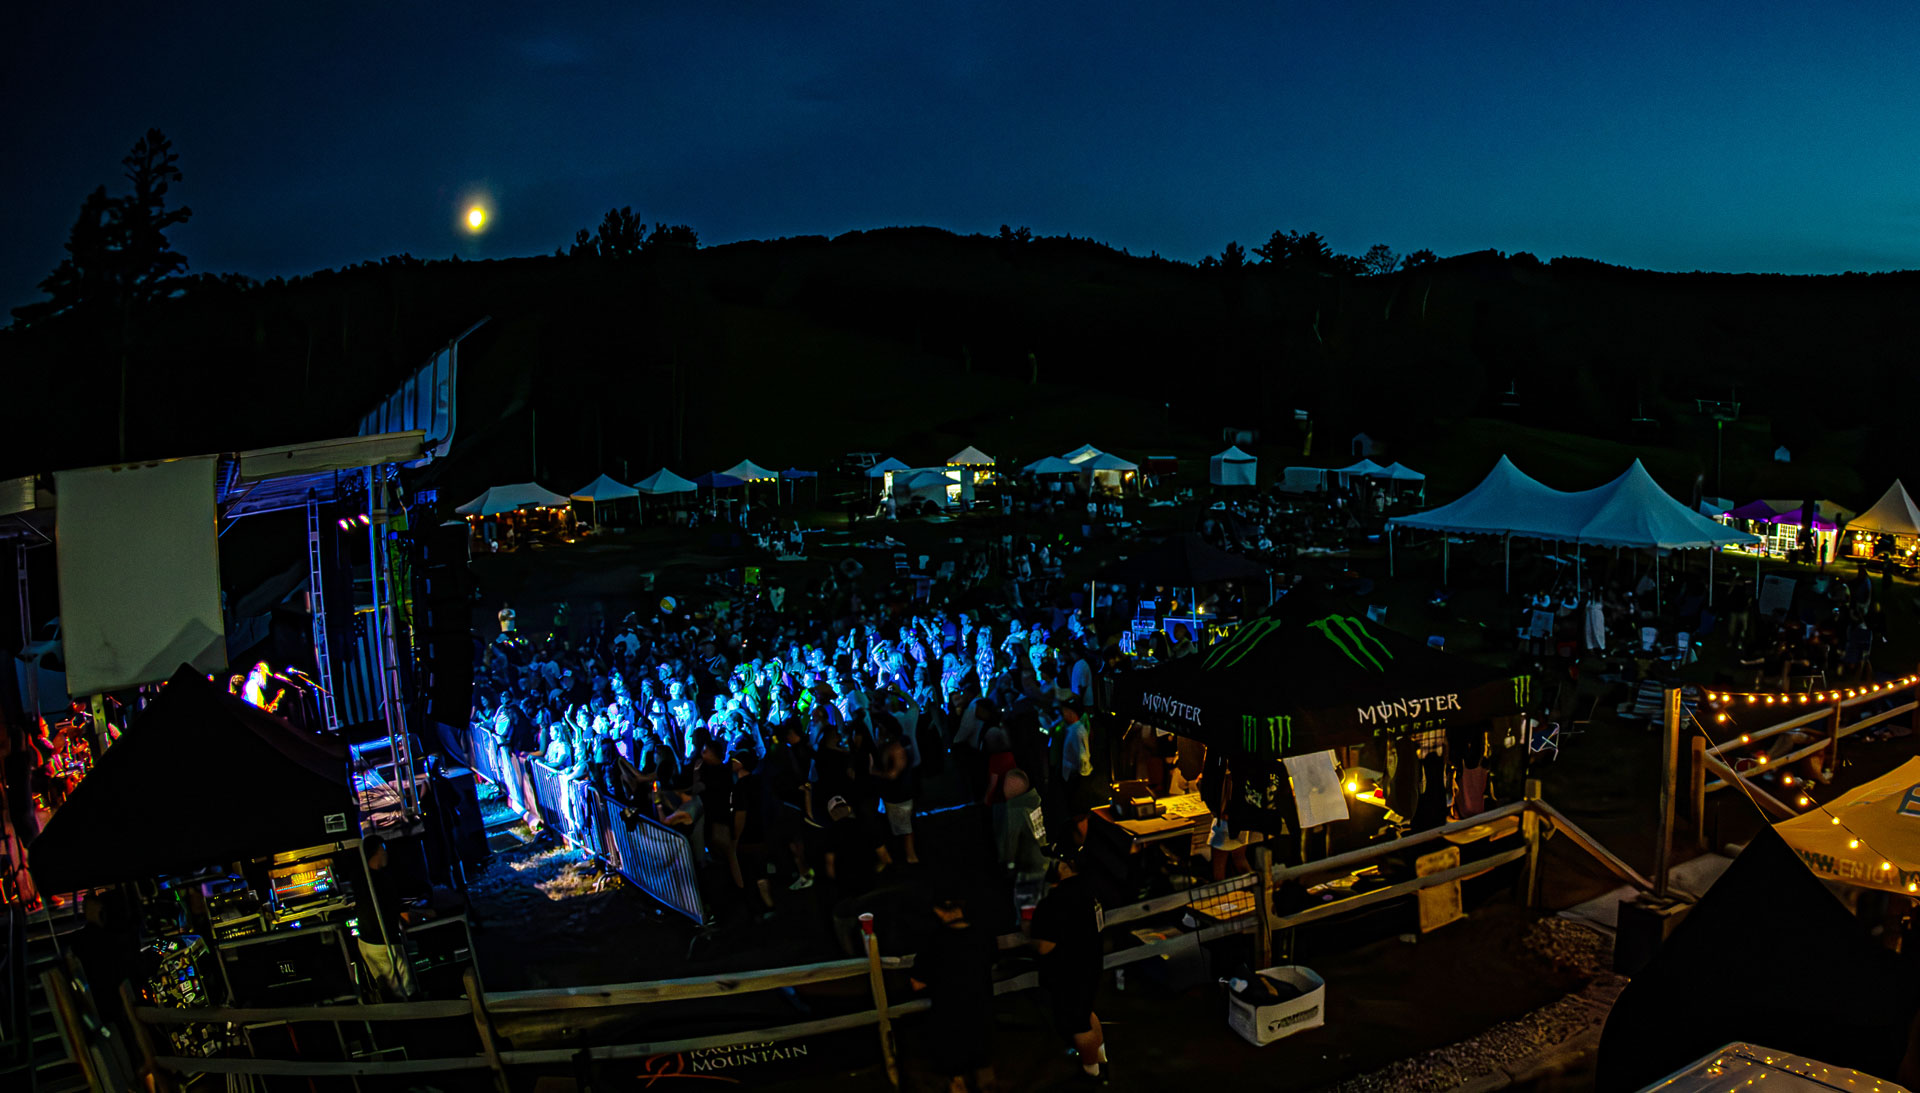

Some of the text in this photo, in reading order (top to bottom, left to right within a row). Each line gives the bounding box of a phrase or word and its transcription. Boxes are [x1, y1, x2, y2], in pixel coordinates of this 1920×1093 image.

[1142, 691, 1202, 726] MONSTER
[1357, 693, 1462, 725] MONSTER
[692, 1044, 808, 1072] MOUNTAIN
